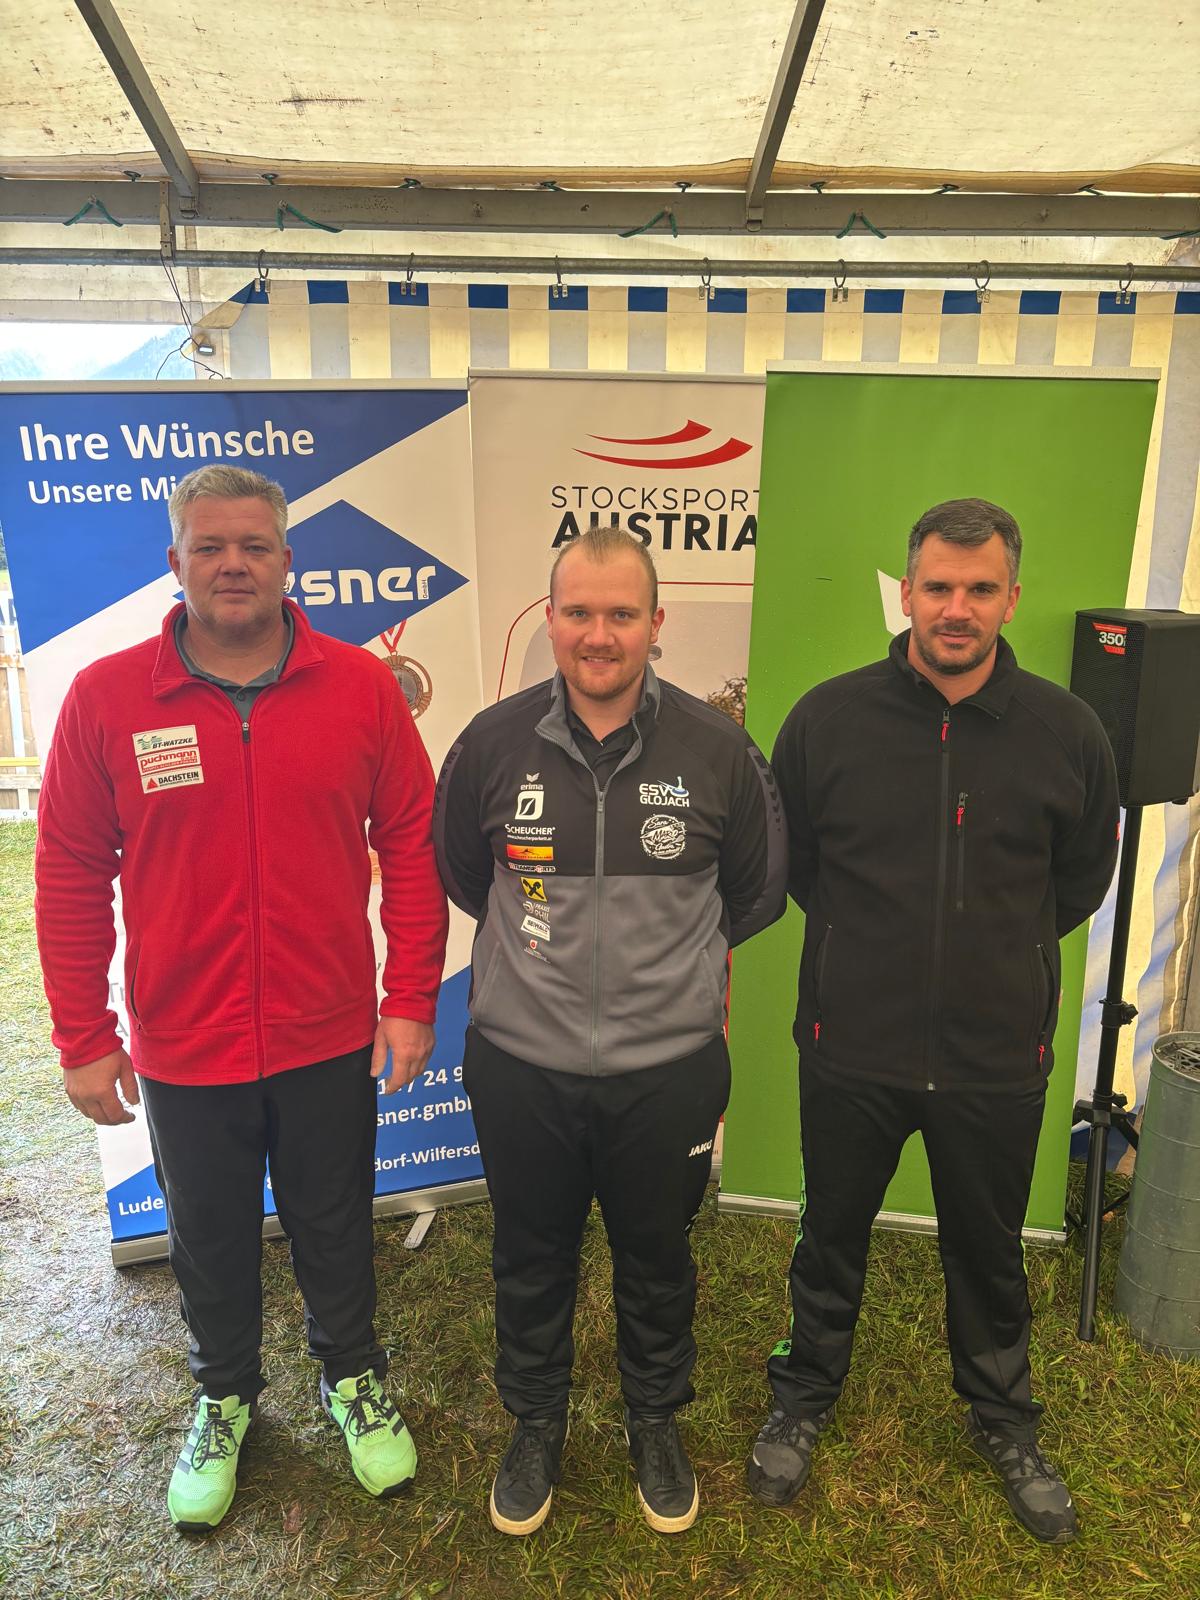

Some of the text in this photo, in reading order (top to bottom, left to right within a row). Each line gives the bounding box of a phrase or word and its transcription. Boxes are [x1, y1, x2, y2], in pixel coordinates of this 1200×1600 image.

[20, 420, 315, 462] Ihre Wünsche
[28, 479, 132, 504] Unsere
[551, 485, 760, 512] STOCKSPOR
[140, 750, 197, 770] puchmann
[158, 771, 199, 784] DACHSTEIN
[520, 782, 544, 791] erima
[639, 783, 669, 797] ESV
[639, 795, 690, 808] GLOJACH
[423, 1068, 448, 1087] 24
[688, 1139, 713, 1158] JAKO
[118, 1195, 164, 1216] Lude
